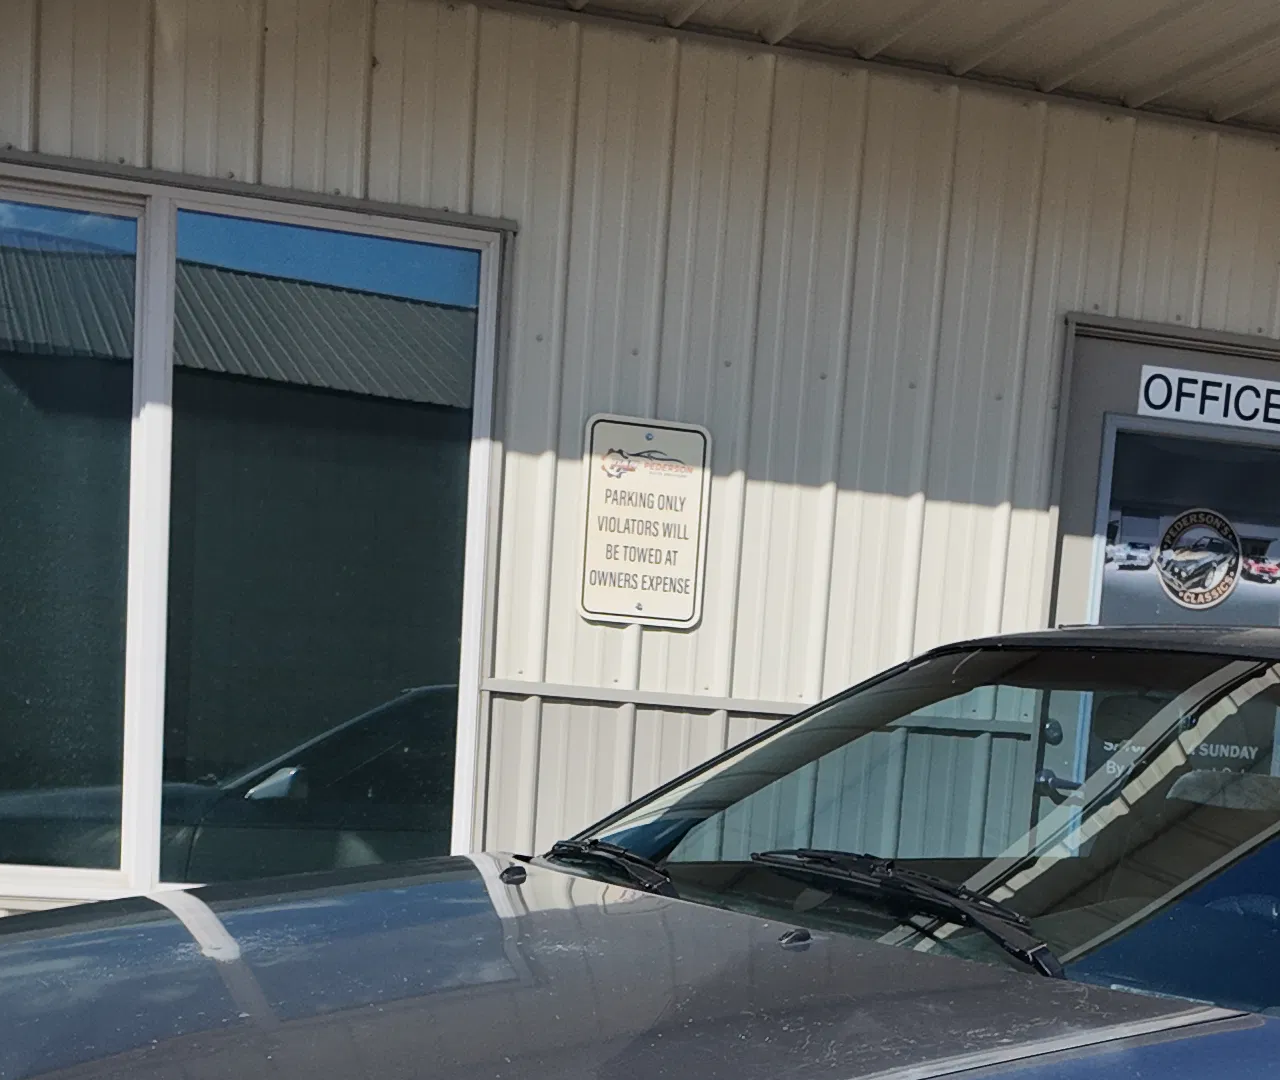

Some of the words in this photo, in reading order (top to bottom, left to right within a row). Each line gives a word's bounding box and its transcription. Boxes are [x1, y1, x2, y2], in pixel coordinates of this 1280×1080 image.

[604, 488, 655, 510] PARKING
[657, 494, 687, 512] ONLY
[597, 515, 659, 537] VIOLATORS
[662, 522, 689, 540] WILL
[1166, 513, 1231, 544] PEDERSON'S
[605, 544, 620, 561] BE
[623, 546, 662, 565] TOWED
[664, 550, 678, 566] AT
[589, 569, 639, 590] OWNERS
[641, 574, 691, 594] EXPENSE
[1183, 574, 1234, 604] CLASSICS
[1199, 743, 1259, 760] SUNDAY
[1106, 760, 1125, 777] By
